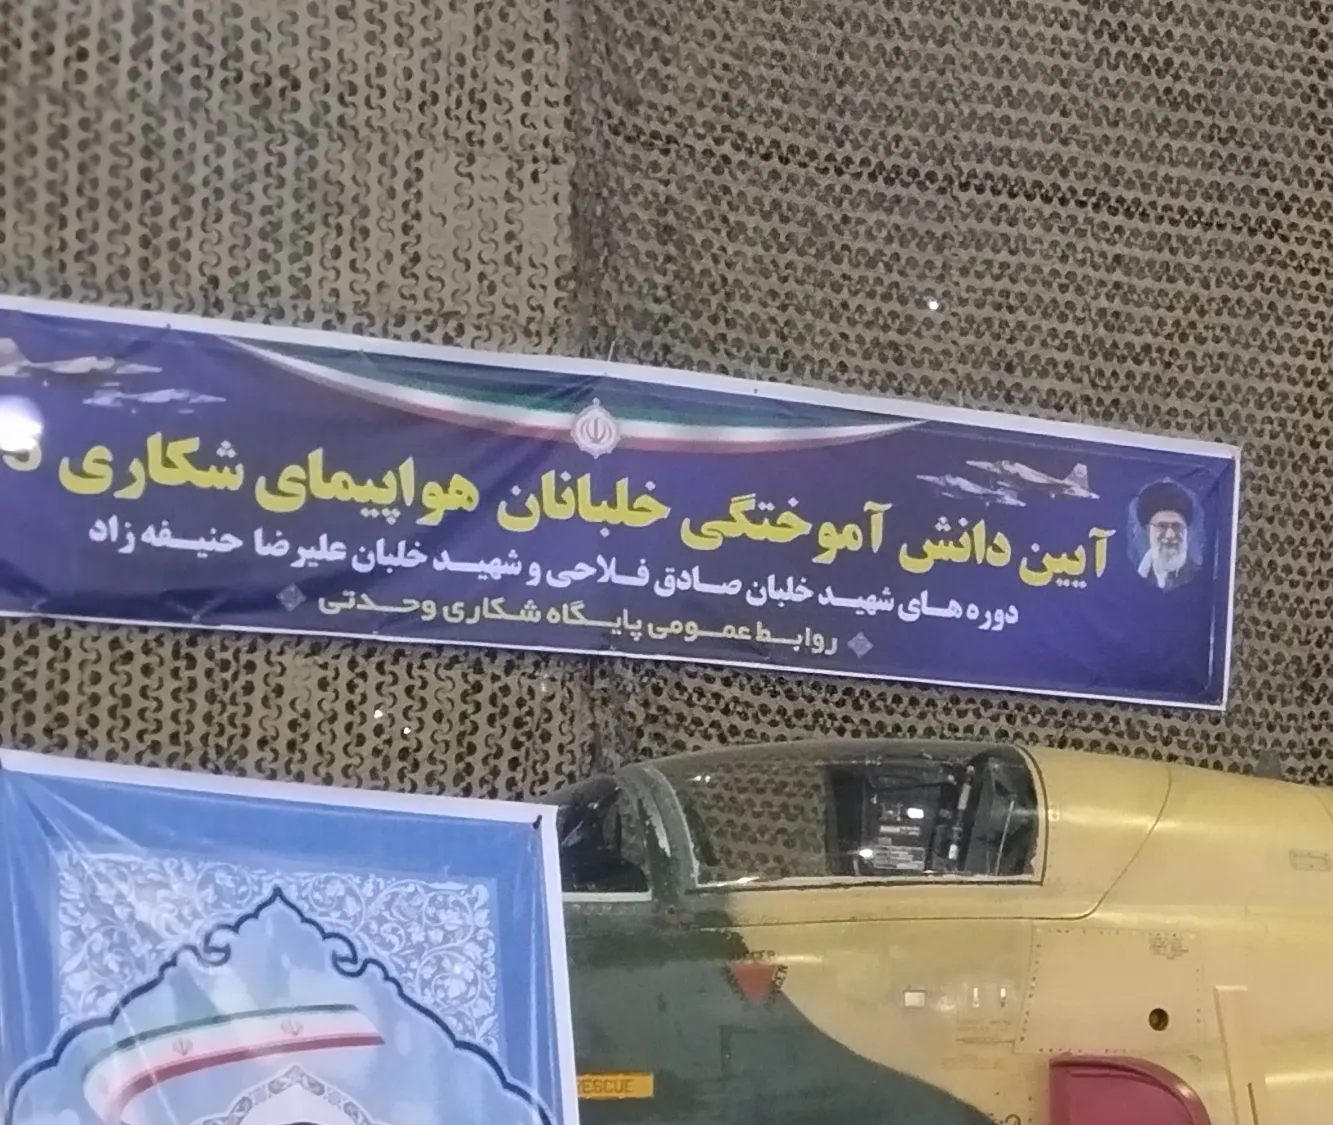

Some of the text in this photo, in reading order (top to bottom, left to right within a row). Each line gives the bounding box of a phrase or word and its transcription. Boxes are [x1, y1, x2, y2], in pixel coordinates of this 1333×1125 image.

[58, 432, 244, 499] شکاری
[254, 448, 480, 525] هواپیمای
[496, 471, 672, 537] خلبانان
[680, 493, 893, 565] آموختگی
[88, 515, 1019, 631] دوره های شهید خلبان صادق فلاحی و شهید خلبان علیرضا حنیفه زاد
[899, 516, 1011, 574] دانش
[1018, 528, 1116, 588] آیین
[317, 589, 838, 655] روابط عمومی پایگاه شکاری وحدتی
